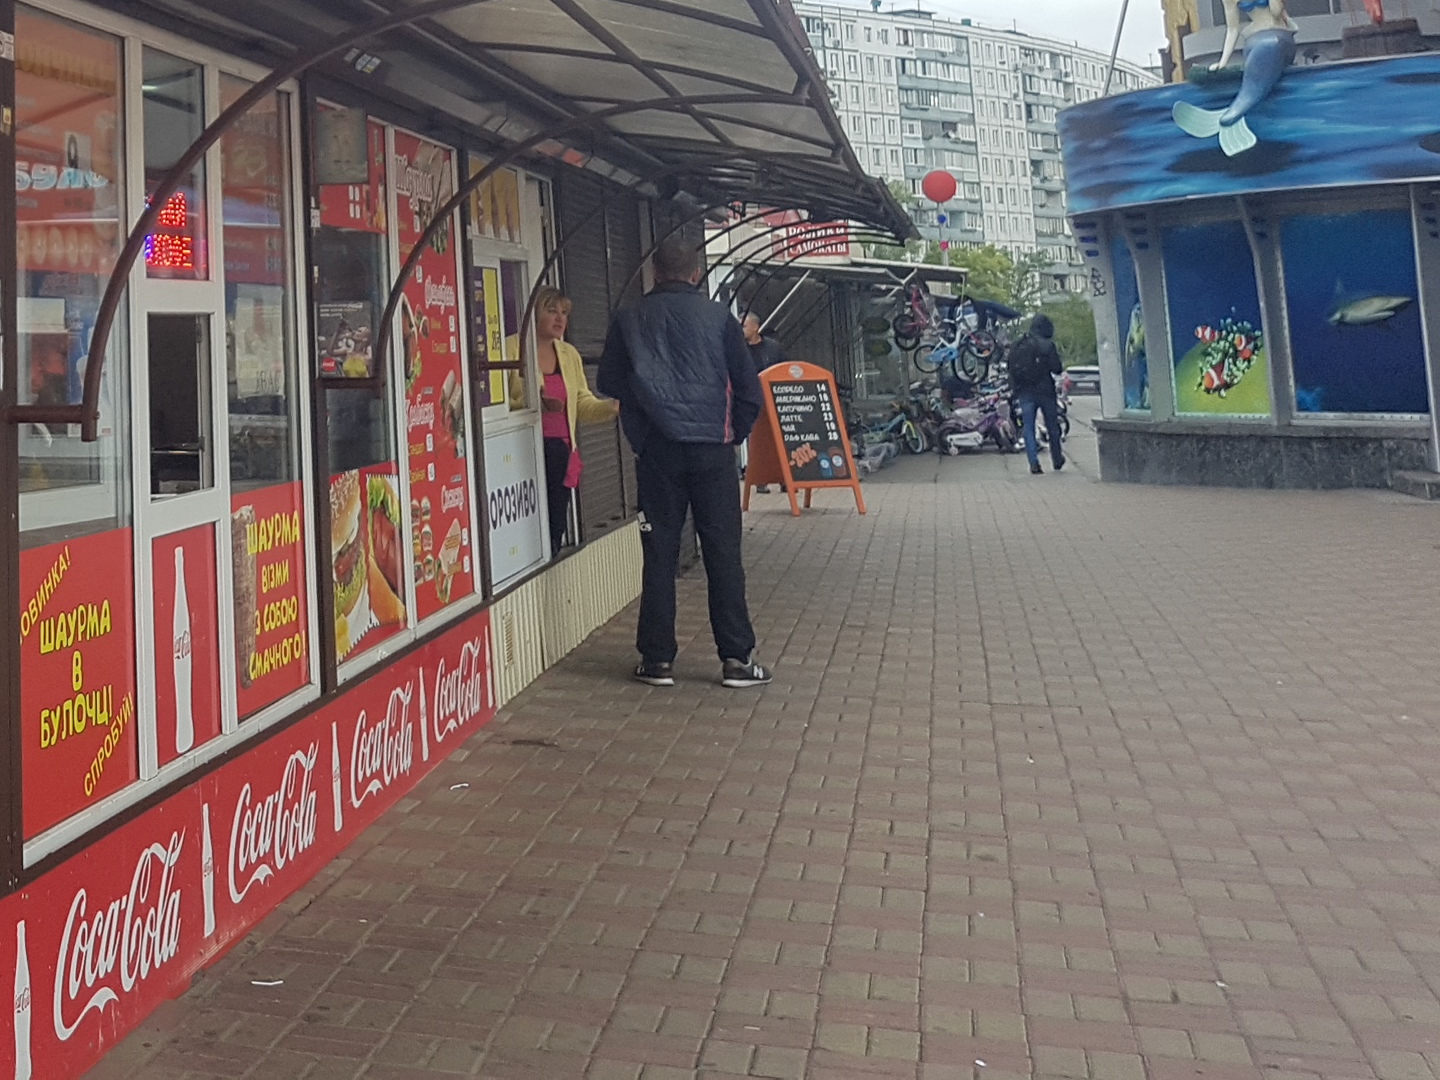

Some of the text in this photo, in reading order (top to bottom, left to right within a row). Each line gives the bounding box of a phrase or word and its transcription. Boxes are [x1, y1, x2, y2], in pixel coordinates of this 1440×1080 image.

[490, 478, 537, 530] ОРОЗИВО
[245, 509, 301, 556] ШАУРМА
[20, 545, 71, 645] ОВИНКА!
[262, 559, 289, 594] ВІЗМИ
[40, 599, 111, 654] ШАУРМА
[264, 595, 298, 632] СОБОЮ
[72, 650, 83, 692] В
[433, 637, 481, 743] Coca-Cola
[350, 680, 414, 809] Coca-Cola
[228, 739, 319, 904] Coca-Cola
[54, 825, 186, 1041] Coca-Cola
